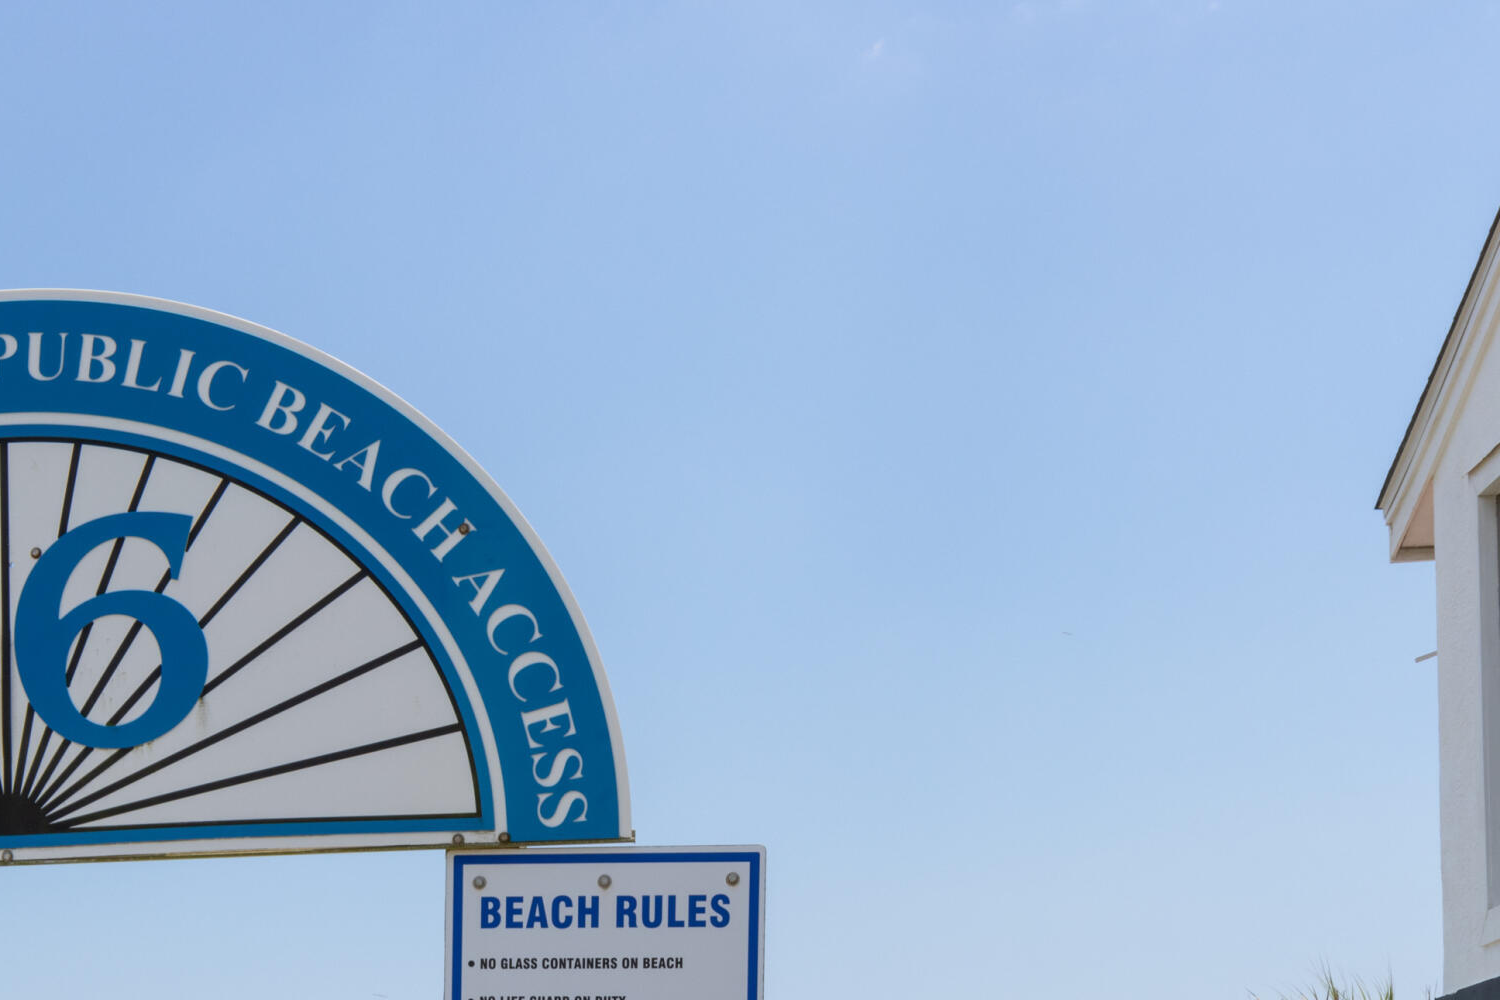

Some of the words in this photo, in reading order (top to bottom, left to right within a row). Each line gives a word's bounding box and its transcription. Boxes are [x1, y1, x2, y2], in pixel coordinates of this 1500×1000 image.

[255, 380, 477, 563] BEACH
[452, 568, 588, 828] ACCESS
[480, 895, 599, 929] BEACH
[616, 893, 730, 928] RULES
[480, 958, 496, 969] NO
[500, 957, 537, 969] GLASS
[541, 957, 617, 969] CONTAINERS
[621, 957, 638, 969] ON
[642, 957, 682, 969] BEACH
